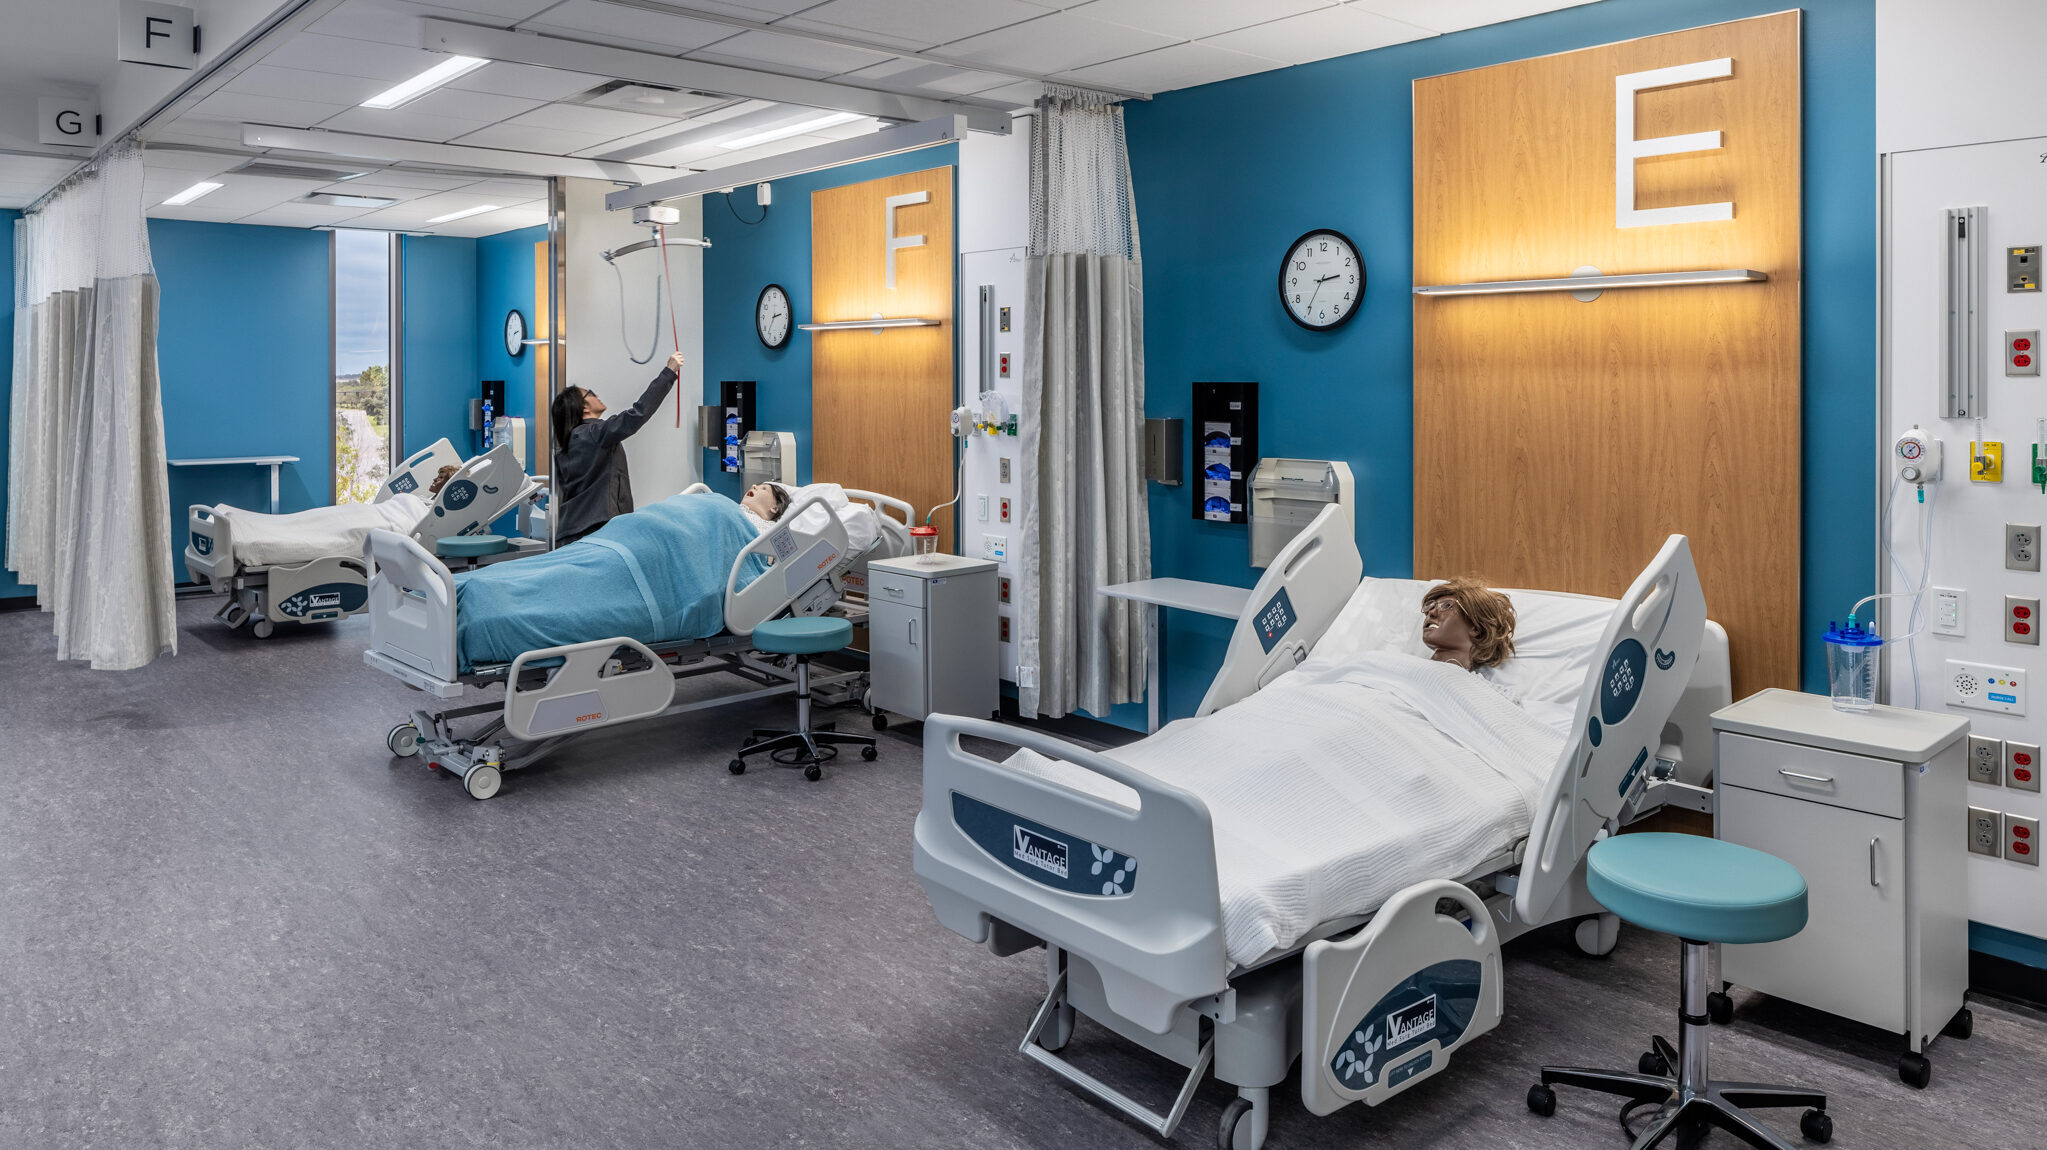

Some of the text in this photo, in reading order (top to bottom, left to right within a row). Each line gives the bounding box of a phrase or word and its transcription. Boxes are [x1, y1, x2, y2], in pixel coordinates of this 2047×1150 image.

[146, 17, 173, 49] F
[55, 110, 82, 135] G
[1616, 58, 1736, 228] E
[886, 191, 930, 289] F
[1319, 242, 1328, 252] 12
[1336, 246, 1340, 256] 1
[1306, 248, 1313, 257] 11
[1296, 261, 1307, 271] 10
[1344, 257, 1351, 267] 2
[1291, 277, 1298, 287] 9
[1348, 274, 1355, 284] 3
[1295, 294, 1301, 304] 8
[1343, 292, 1350, 301] 4
[1307, 305, 1312, 316] 7
[1319, 309, 1326, 320] 6
[1333, 304, 1340, 315] 5
[817, 553, 837, 570] ROTEC
[576, 712, 602, 722] ROTEC
[1015, 826, 1066, 868] VANTAGE
[1388, 1009, 1434, 1039] VANTAGE
